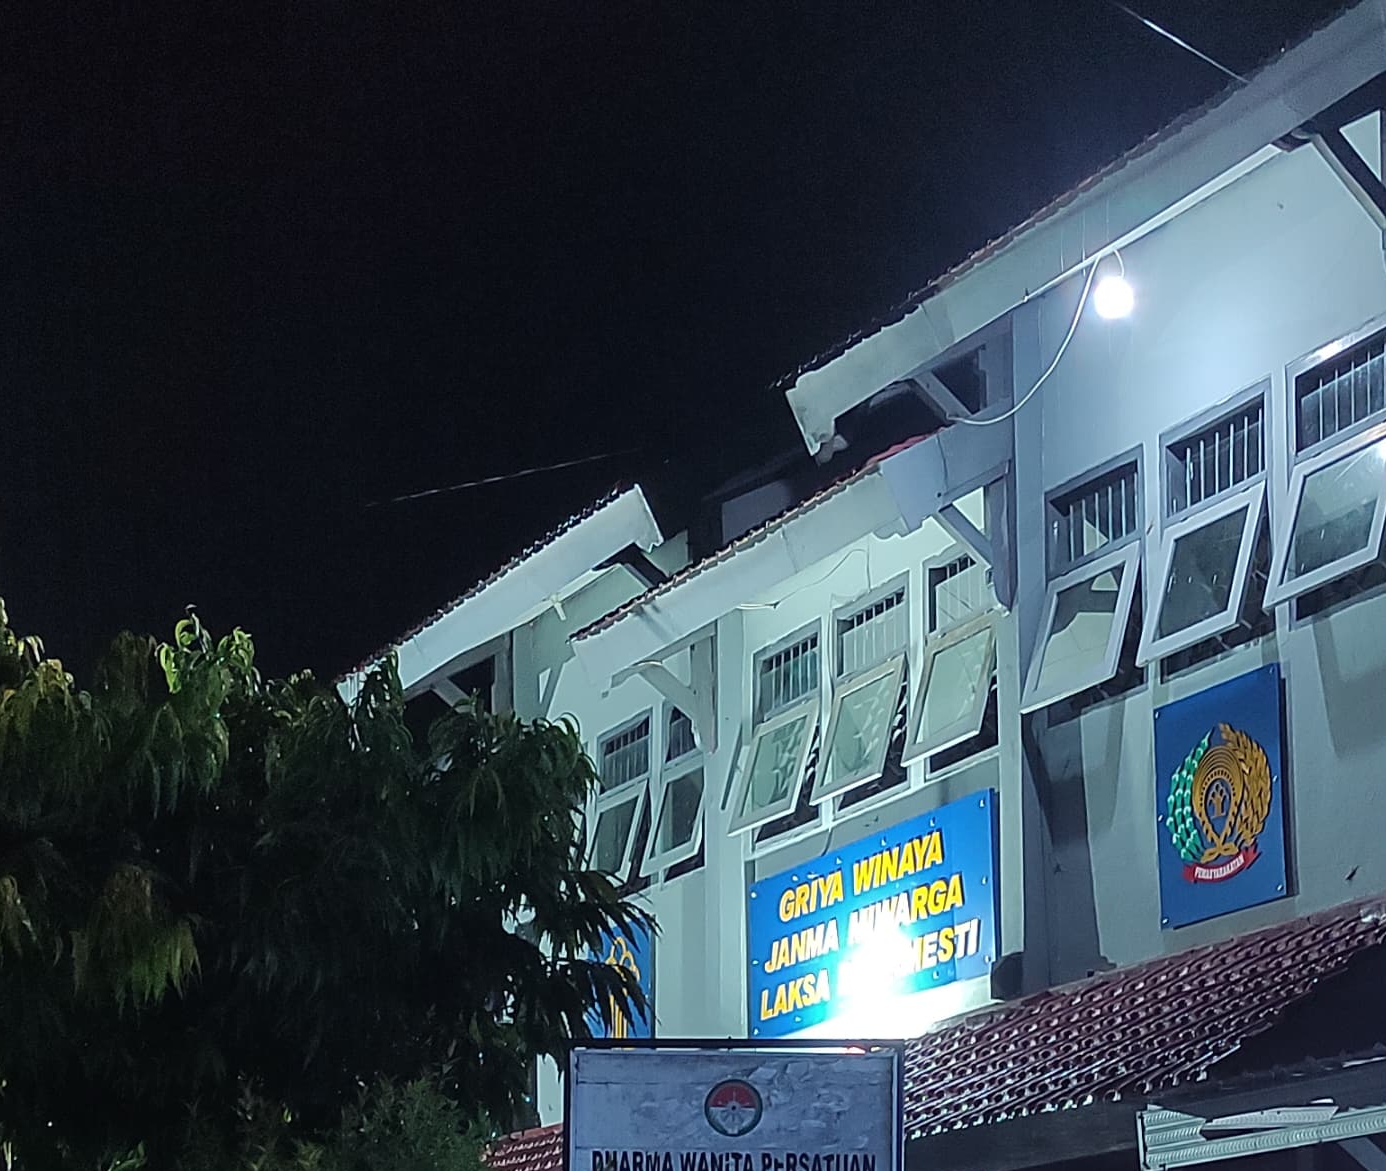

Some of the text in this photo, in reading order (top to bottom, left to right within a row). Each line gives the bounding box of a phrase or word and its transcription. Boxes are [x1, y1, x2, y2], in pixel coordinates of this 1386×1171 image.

[779, 831, 944, 922] GRIYA WINAYA
[764, 919, 840, 973] JANMA
[760, 968, 831, 1021] LAKSA
